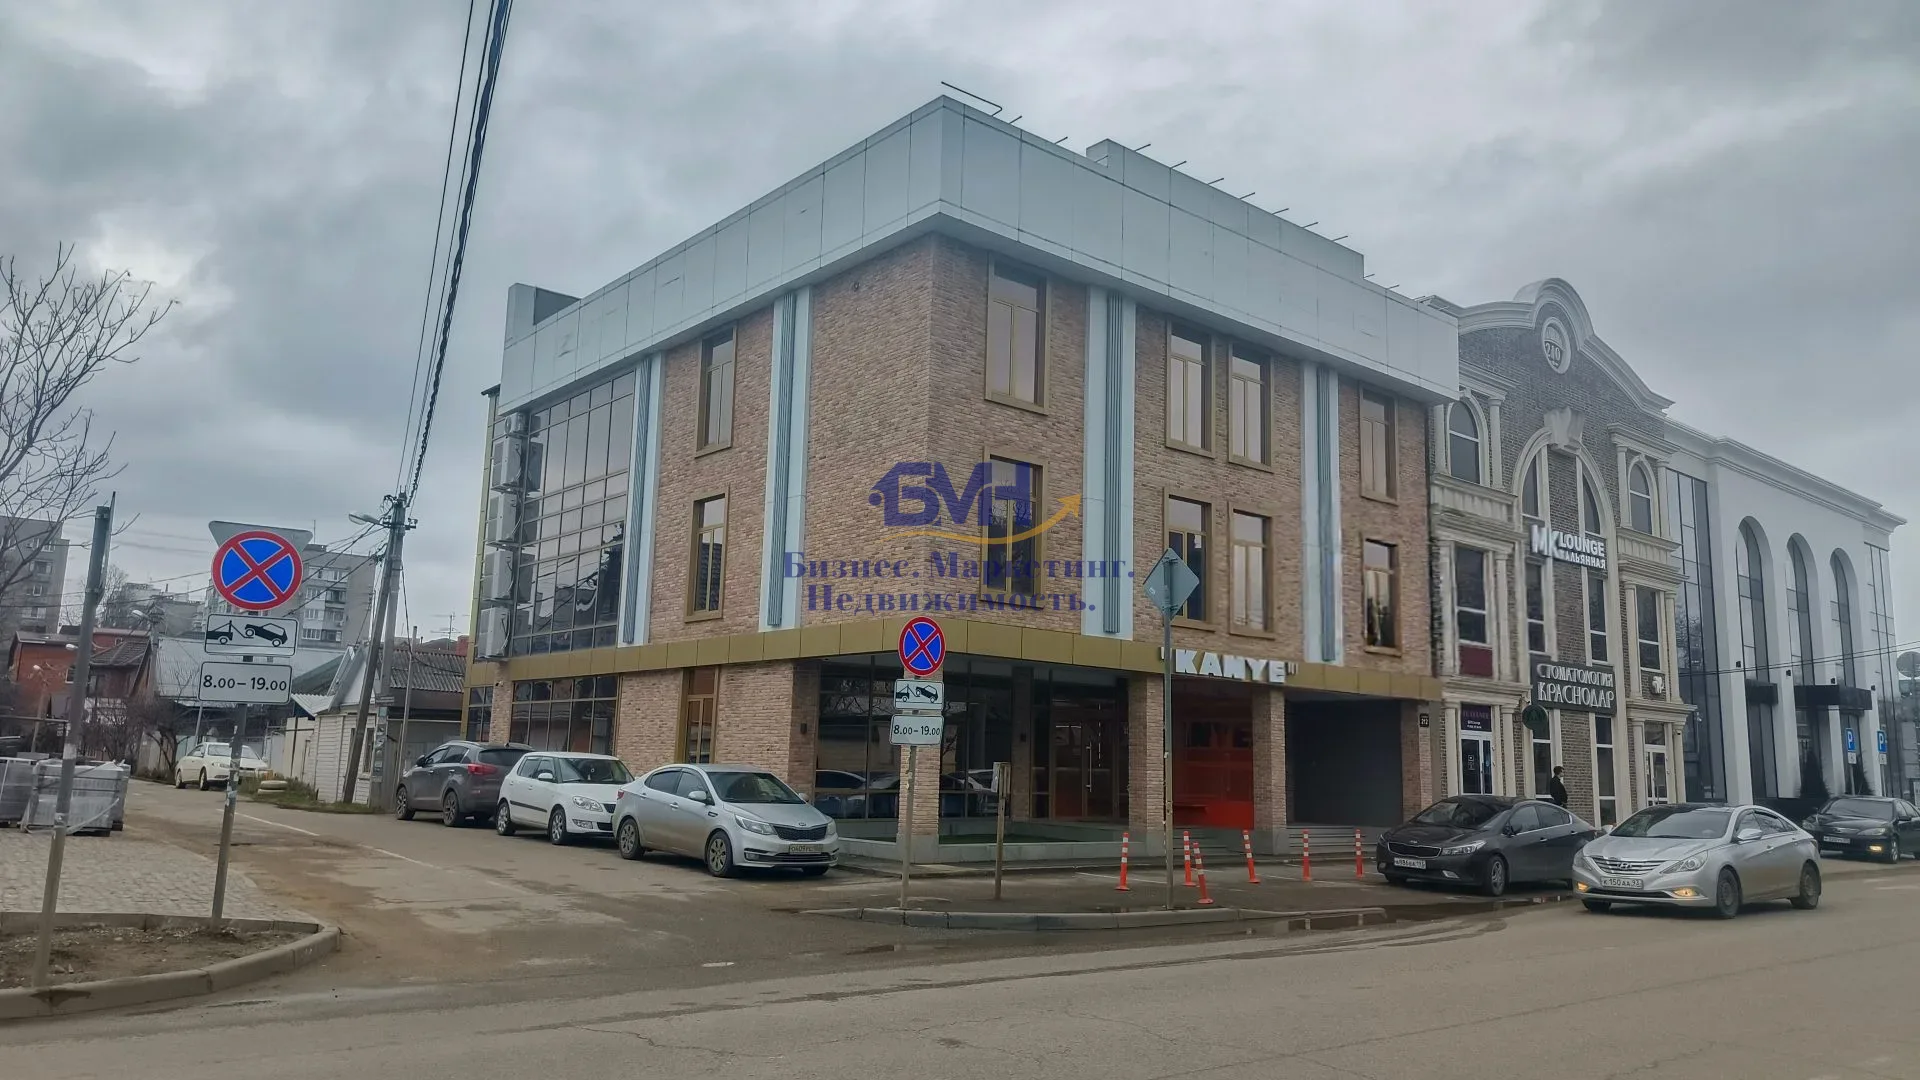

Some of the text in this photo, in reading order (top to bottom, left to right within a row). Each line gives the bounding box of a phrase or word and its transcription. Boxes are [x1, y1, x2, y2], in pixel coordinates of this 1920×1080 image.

[1558, 531, 1605, 557] LOUNGE
[1536, 663, 1614, 688] СТОМАТОЛОГИЯ
[1537, 682, 1615, 709] КРАСНОДАР
